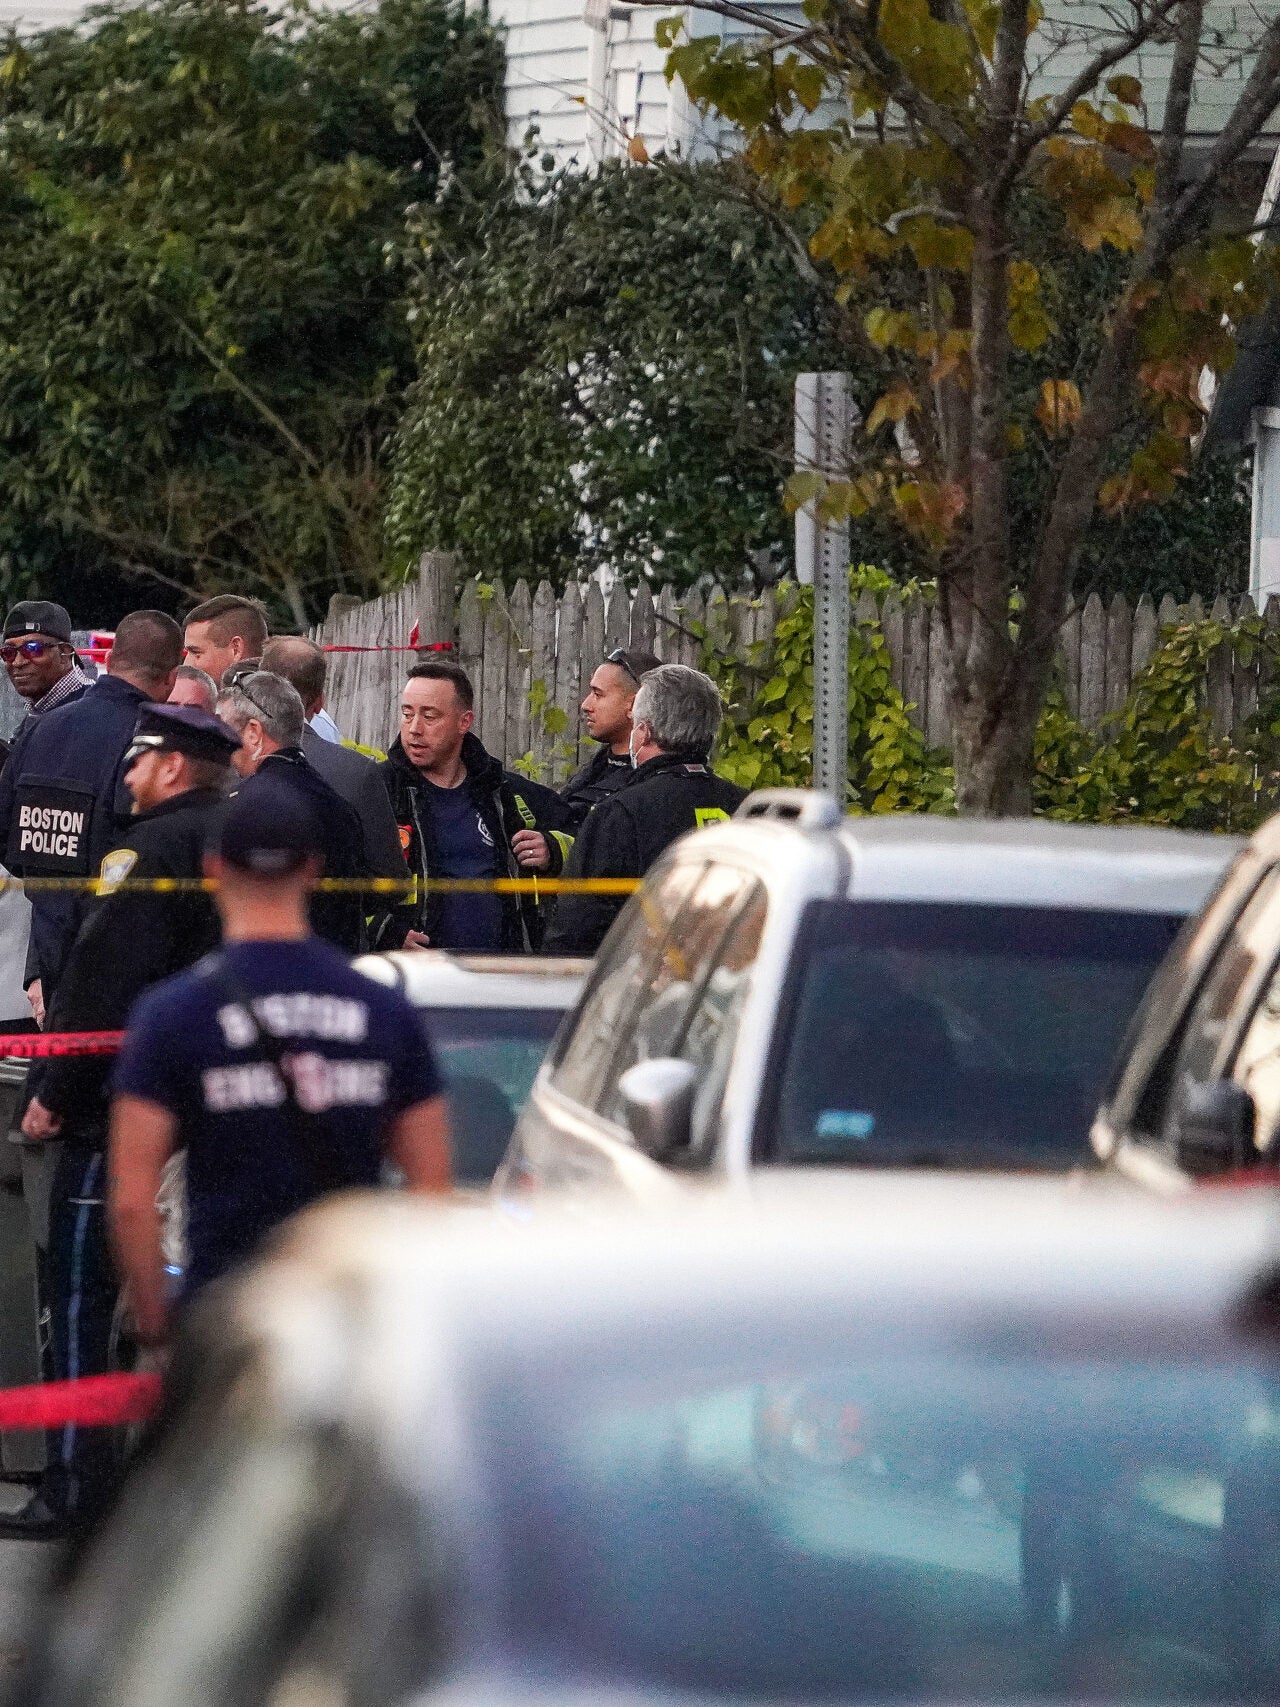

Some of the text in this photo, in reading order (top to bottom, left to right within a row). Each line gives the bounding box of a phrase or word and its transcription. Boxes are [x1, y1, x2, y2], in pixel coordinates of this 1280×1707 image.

[19, 805, 84, 834] BOSTON
[20, 829, 79, 858] POLICE
[218, 993, 368, 1047] BSTON
